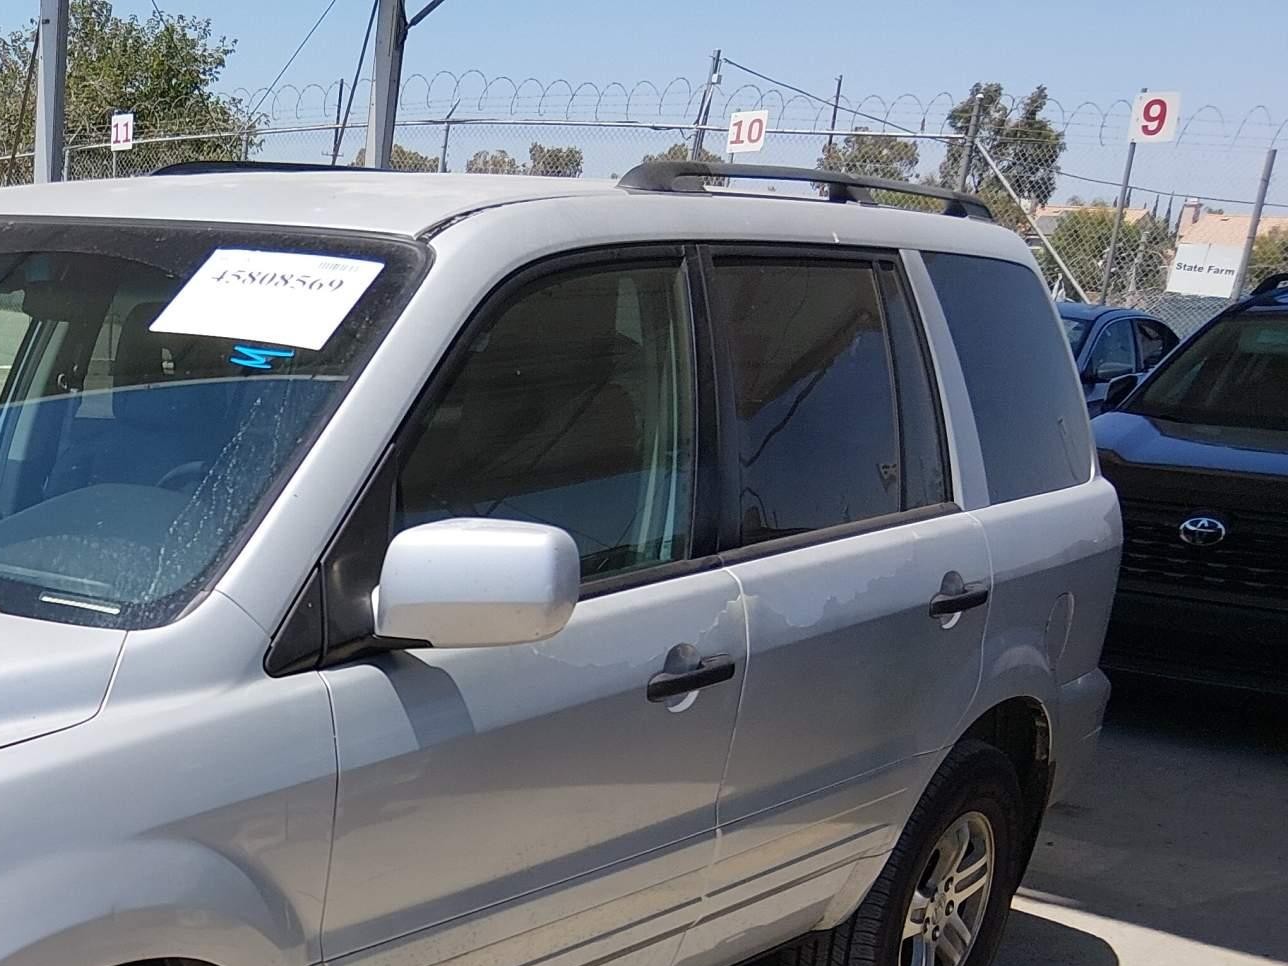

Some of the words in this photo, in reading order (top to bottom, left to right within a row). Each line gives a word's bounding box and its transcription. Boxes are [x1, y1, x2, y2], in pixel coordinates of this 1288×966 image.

[1141, 98, 1167, 136] 9
[112, 121, 131, 144] 11
[729, 118, 764, 145] 10
[211, 269, 344, 292] 45808569
[1175, 262, 1204, 273] State
[1207, 265, 1235, 276] Farm
